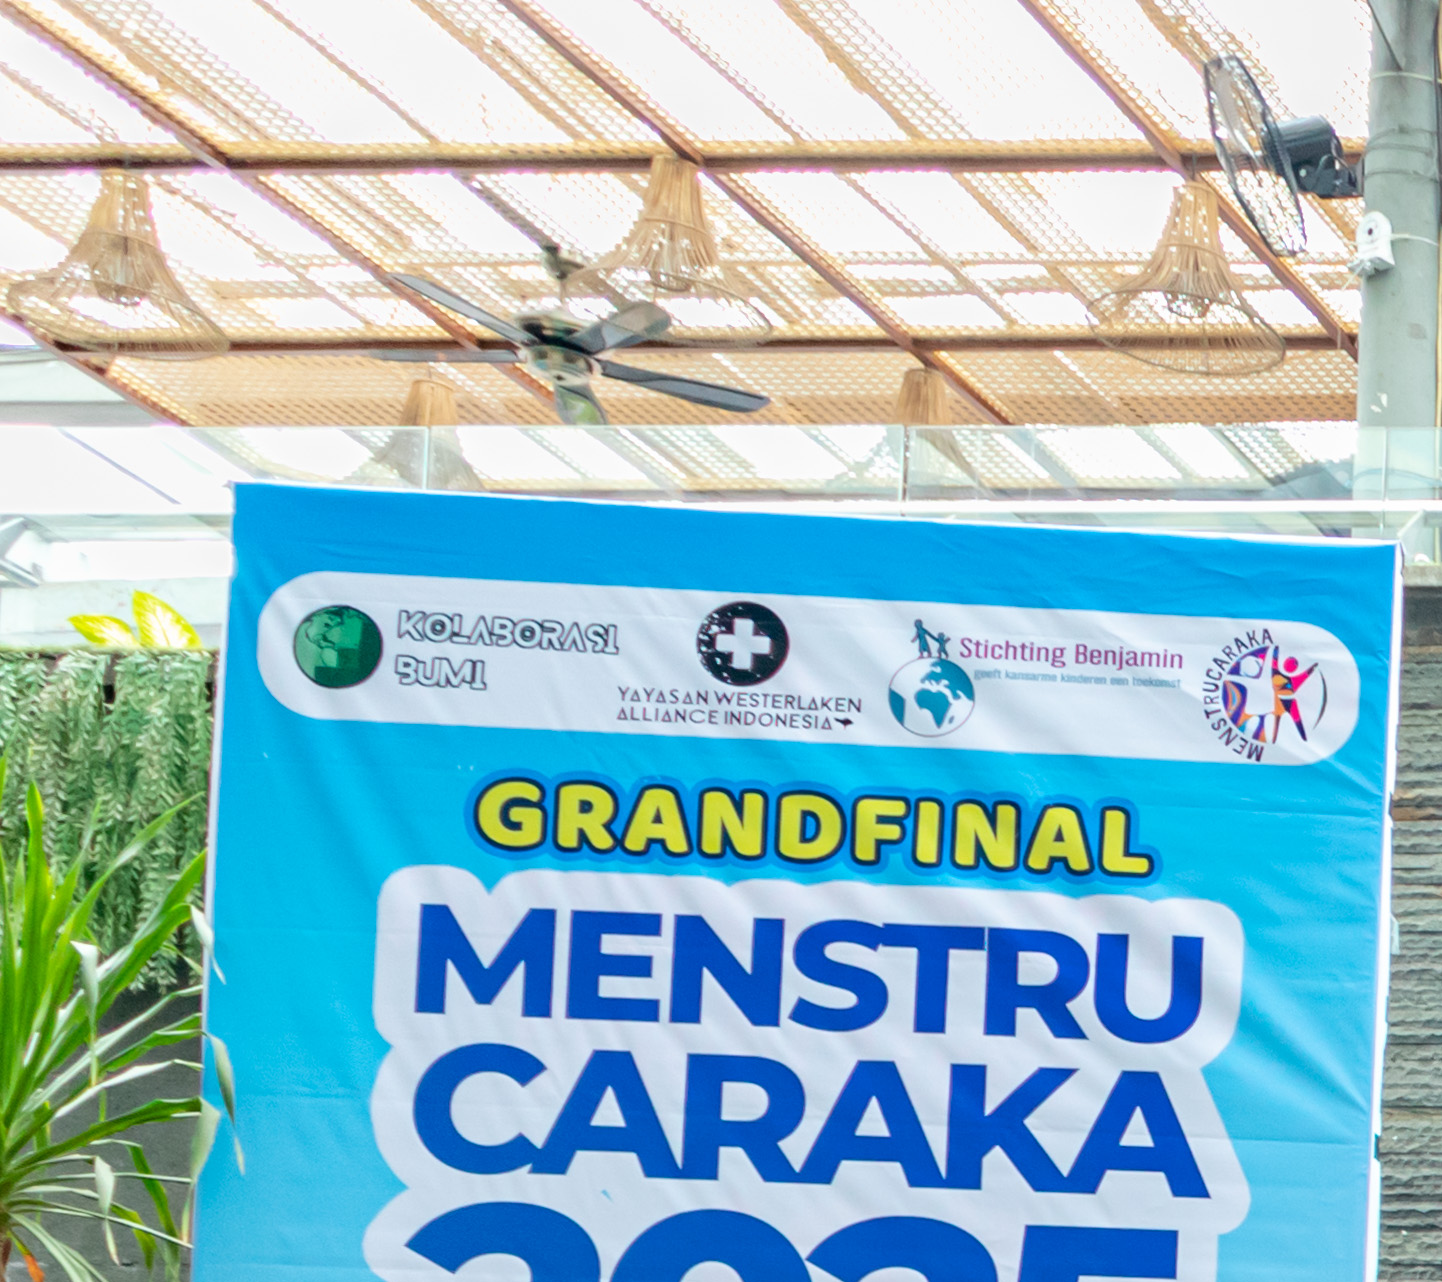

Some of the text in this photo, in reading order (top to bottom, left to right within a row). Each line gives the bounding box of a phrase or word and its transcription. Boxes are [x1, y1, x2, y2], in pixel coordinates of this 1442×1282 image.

[399, 610, 619, 654] KOLABORASI
[960, 637, 1183, 671] Stichting Benjamin
[396, 655, 486, 691] BUMI
[1203, 628, 1273, 762] MENSTRUCARAKA
[618, 686, 861, 712] YAYASAN WESTERLAKEN
[618, 707, 832, 730] ALLIANCE INDONESIA
[476, 779, 1154, 877] GRANDFINAL
[414, 903, 1204, 1044] MENSTRU
[413, 1042, 1211, 1198] CARAKA
